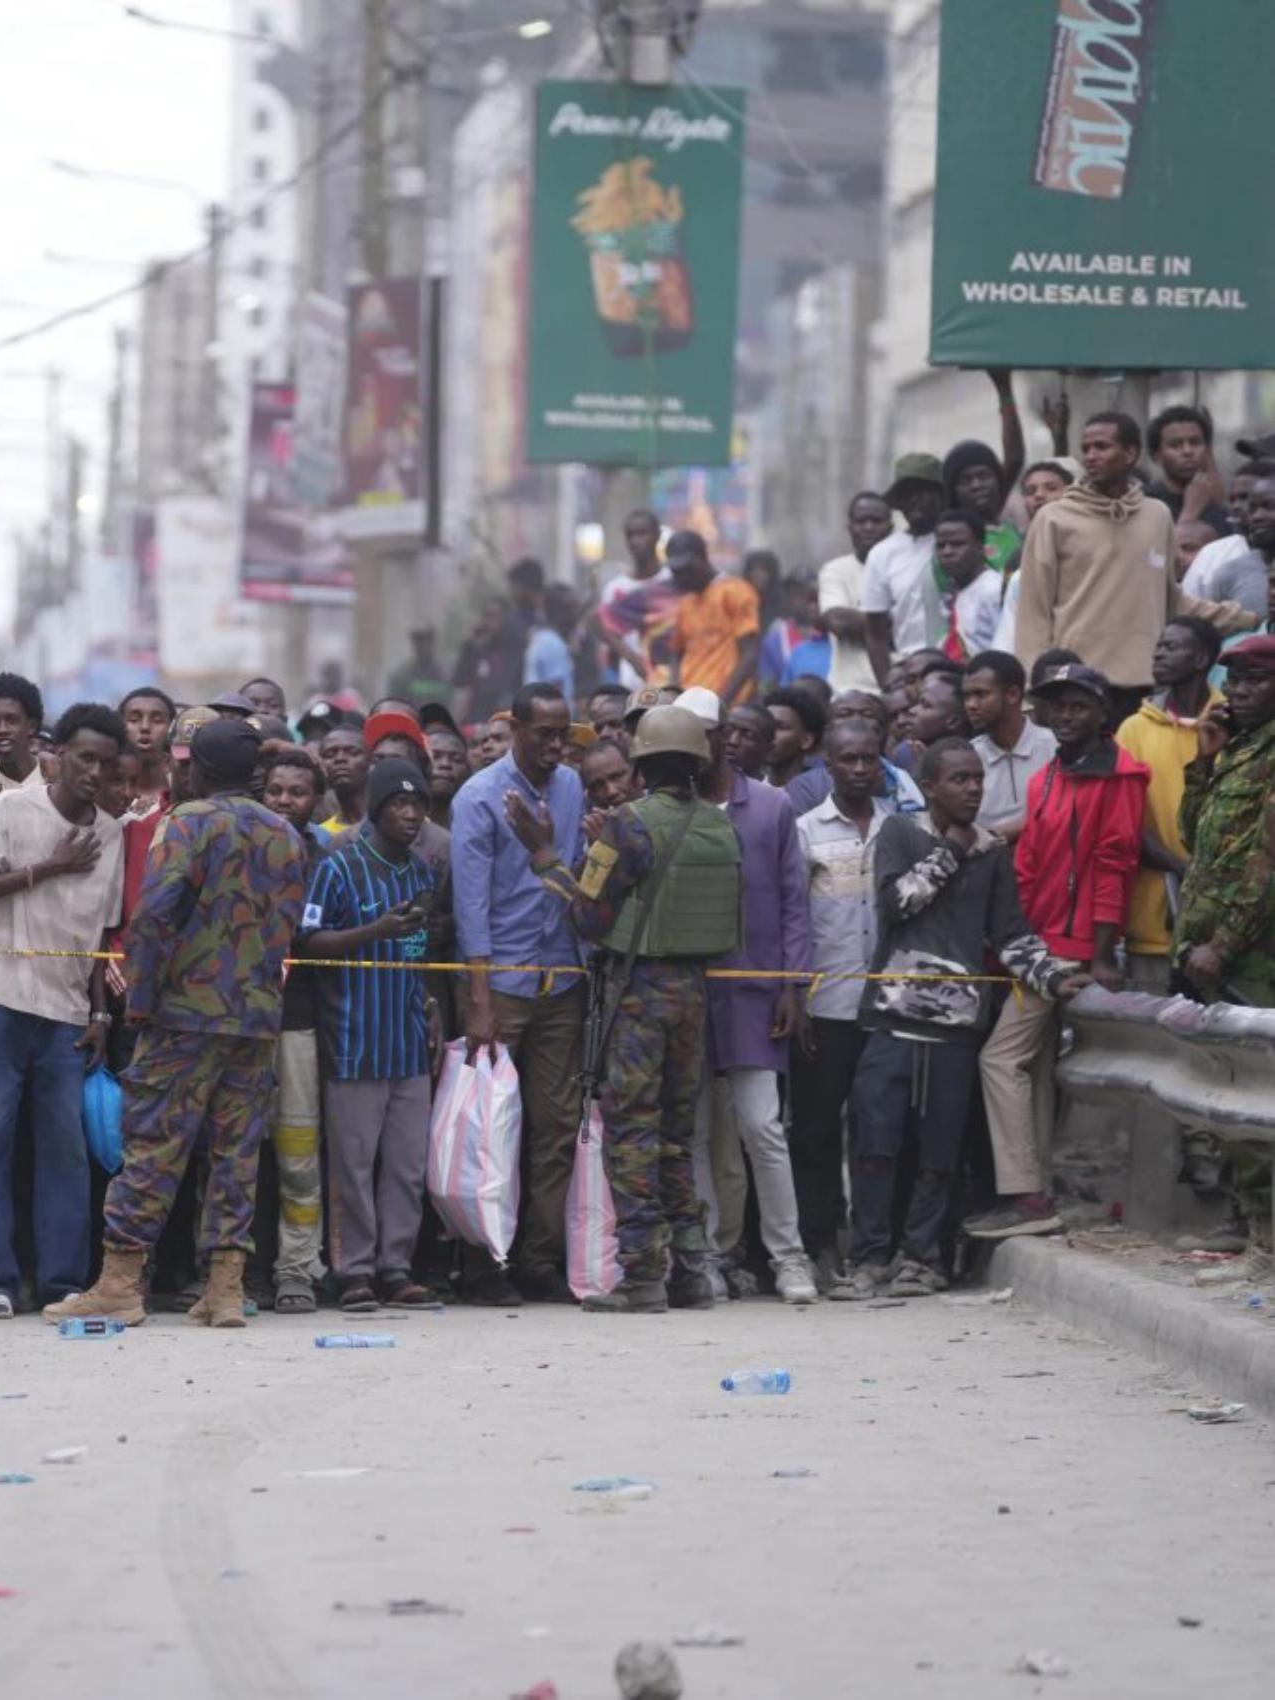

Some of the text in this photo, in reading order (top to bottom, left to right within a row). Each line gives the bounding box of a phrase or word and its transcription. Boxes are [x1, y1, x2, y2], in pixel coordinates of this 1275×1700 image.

[1010, 252, 1191, 275] AVAILABLE IN
[961, 282, 1247, 309] WHOLESALE & RETAIL
